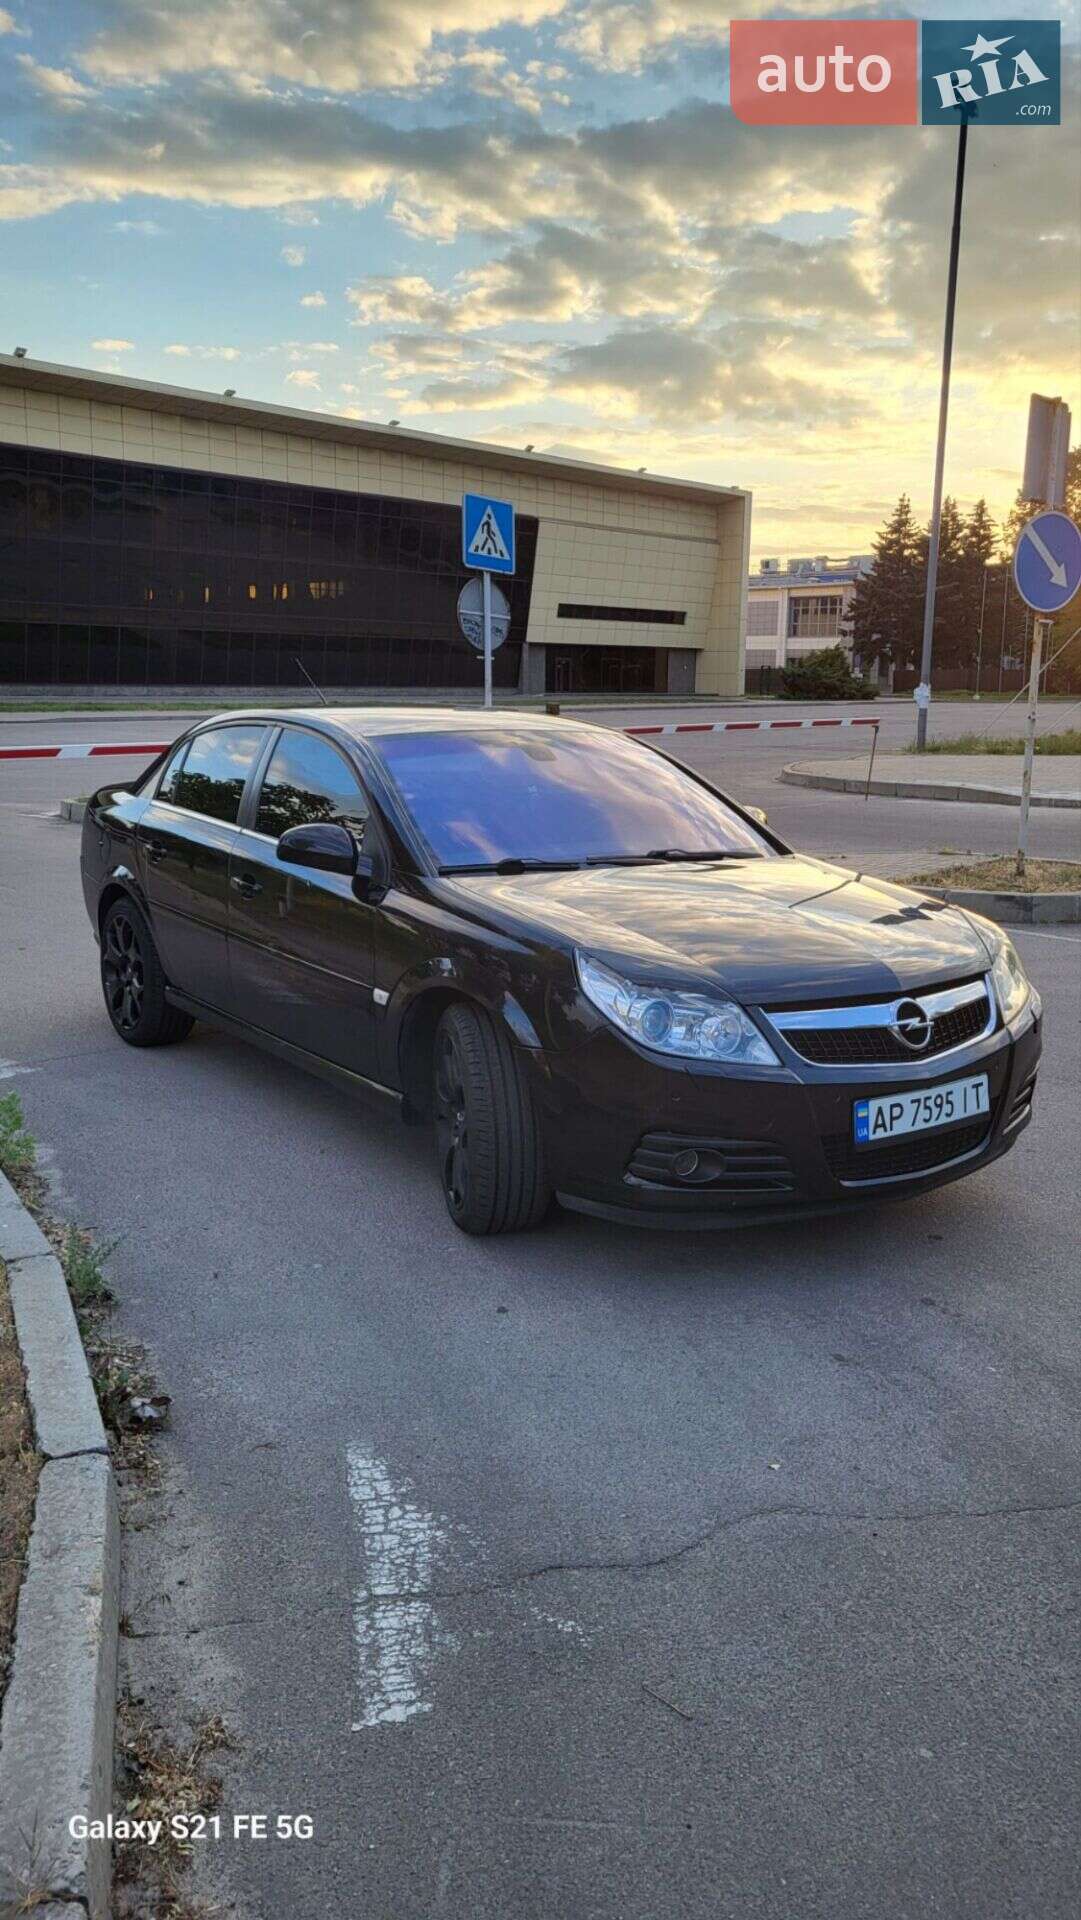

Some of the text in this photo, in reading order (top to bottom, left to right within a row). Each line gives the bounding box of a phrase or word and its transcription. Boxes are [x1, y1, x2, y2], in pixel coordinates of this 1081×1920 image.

[872, 1082, 984, 1135] AP 7595 IT
[857, 1127, 868, 1137] UA
